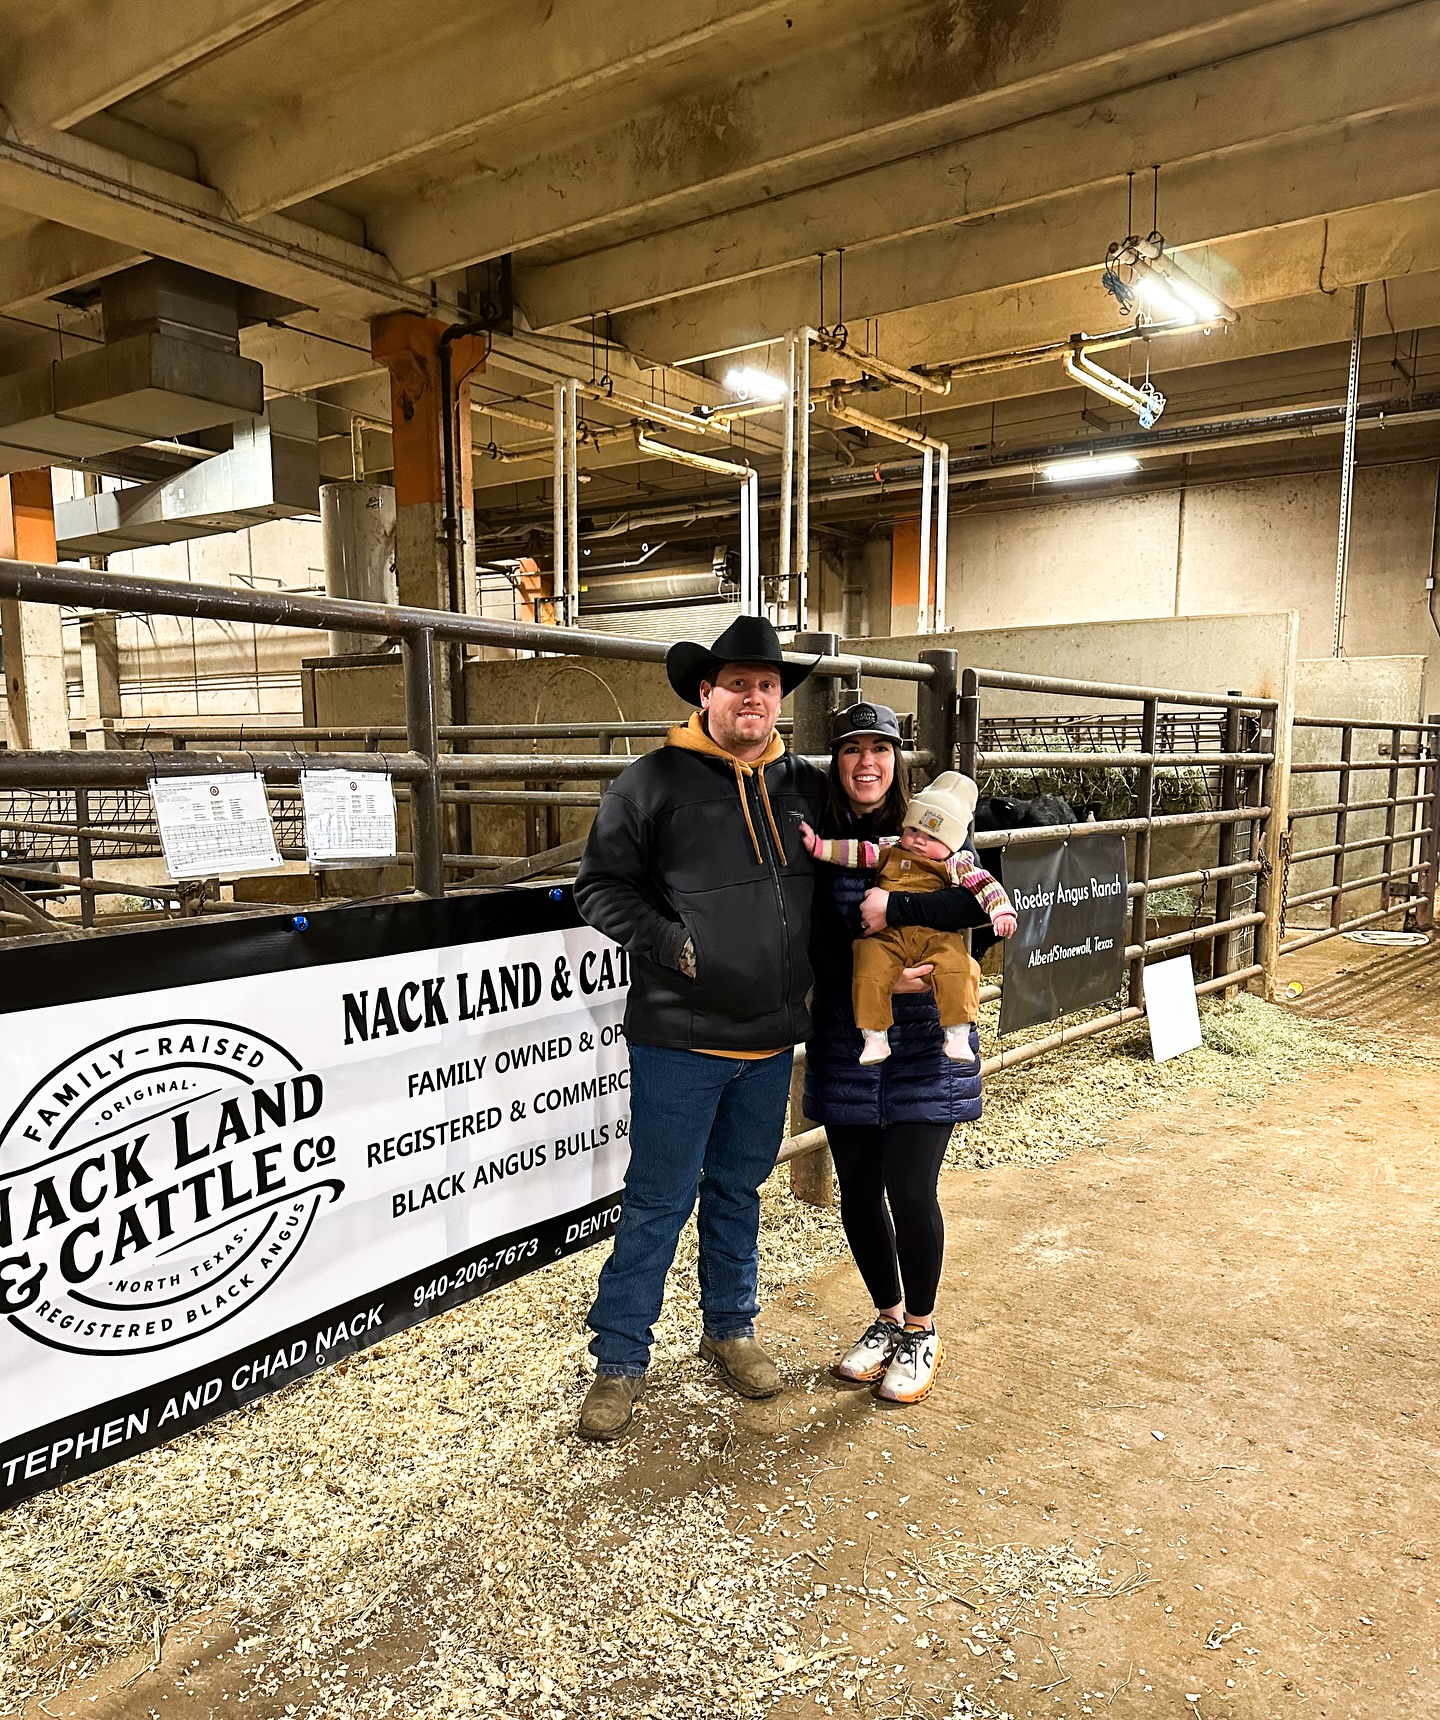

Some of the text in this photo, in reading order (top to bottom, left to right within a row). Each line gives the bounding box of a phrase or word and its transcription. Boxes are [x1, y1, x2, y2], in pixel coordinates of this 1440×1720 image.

[1014, 873, 1122, 911] Roeder Angus Ranch
[342, 976, 449, 1046] NACK
[456, 961, 542, 1022] LAND
[550, 955, 573, 1002] &
[1027, 935, 1114, 968] Albert/Stonewall, Texas
[408, 1055, 487, 1099] FAMILY
[494, 1036, 572, 1074] OWNED
[578, 1031, 595, 1053] &
[170, 1073, 323, 1171] LAND
[367, 1068, 631, 1168] REGISTERED & COMMERC
[392, 1119, 629, 1219] BLACK ANGUS BULLS &
[0, 1251, 48, 1316] &
[59, 1142, 287, 1284] CATTLE
[35, 1203, 305, 1338] REGISTERED BLACK ANGUS
[157, 1377, 223, 1427] AND
[231, 1340, 308, 1391] CHAD
[315, 1303, 385, 1355] NACK
[413, 1237, 539, 1308] 940-206-7673
